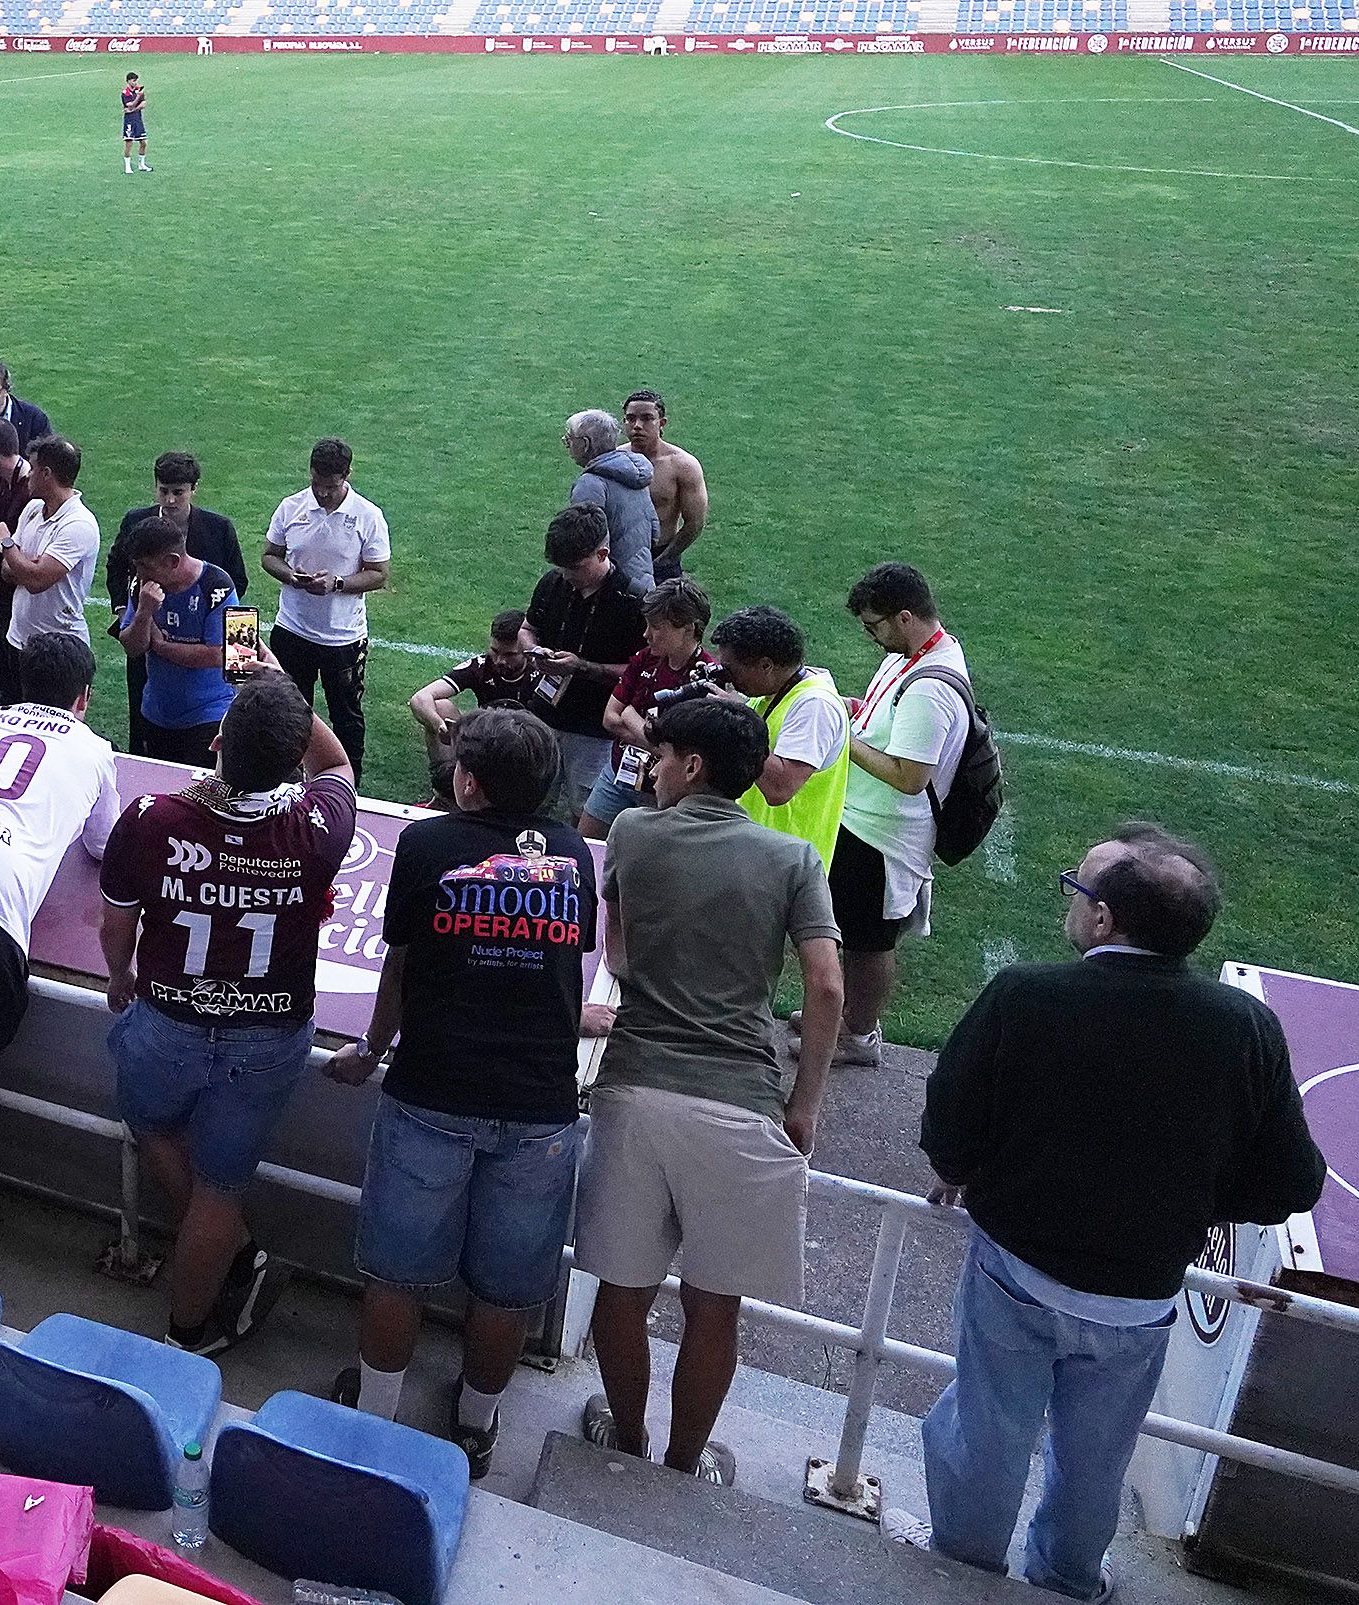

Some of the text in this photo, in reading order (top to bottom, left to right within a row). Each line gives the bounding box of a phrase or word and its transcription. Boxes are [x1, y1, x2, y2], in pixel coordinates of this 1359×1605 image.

[958, 38, 994, 47] VERSUS
[1018, 36, 1079, 50] FEDERACIÓN
[1130, 35, 1193, 50] FEDERACIÓN
[1216, 37, 1258, 47] VERSUS
[1312, 37, 1359, 50] FEDERAC
[23, 719, 71, 734] PINO
[219, 852, 301, 869] Deputación
[219, 862, 302, 879] Pontevedra
[161, 876, 304, 908] M. CUESTA
[435, 879, 580, 924] Smooth
[433, 912, 580, 946] OPERATOR
[172, 910, 277, 978] 11
[151, 981, 292, 1013] PESCAMAR
